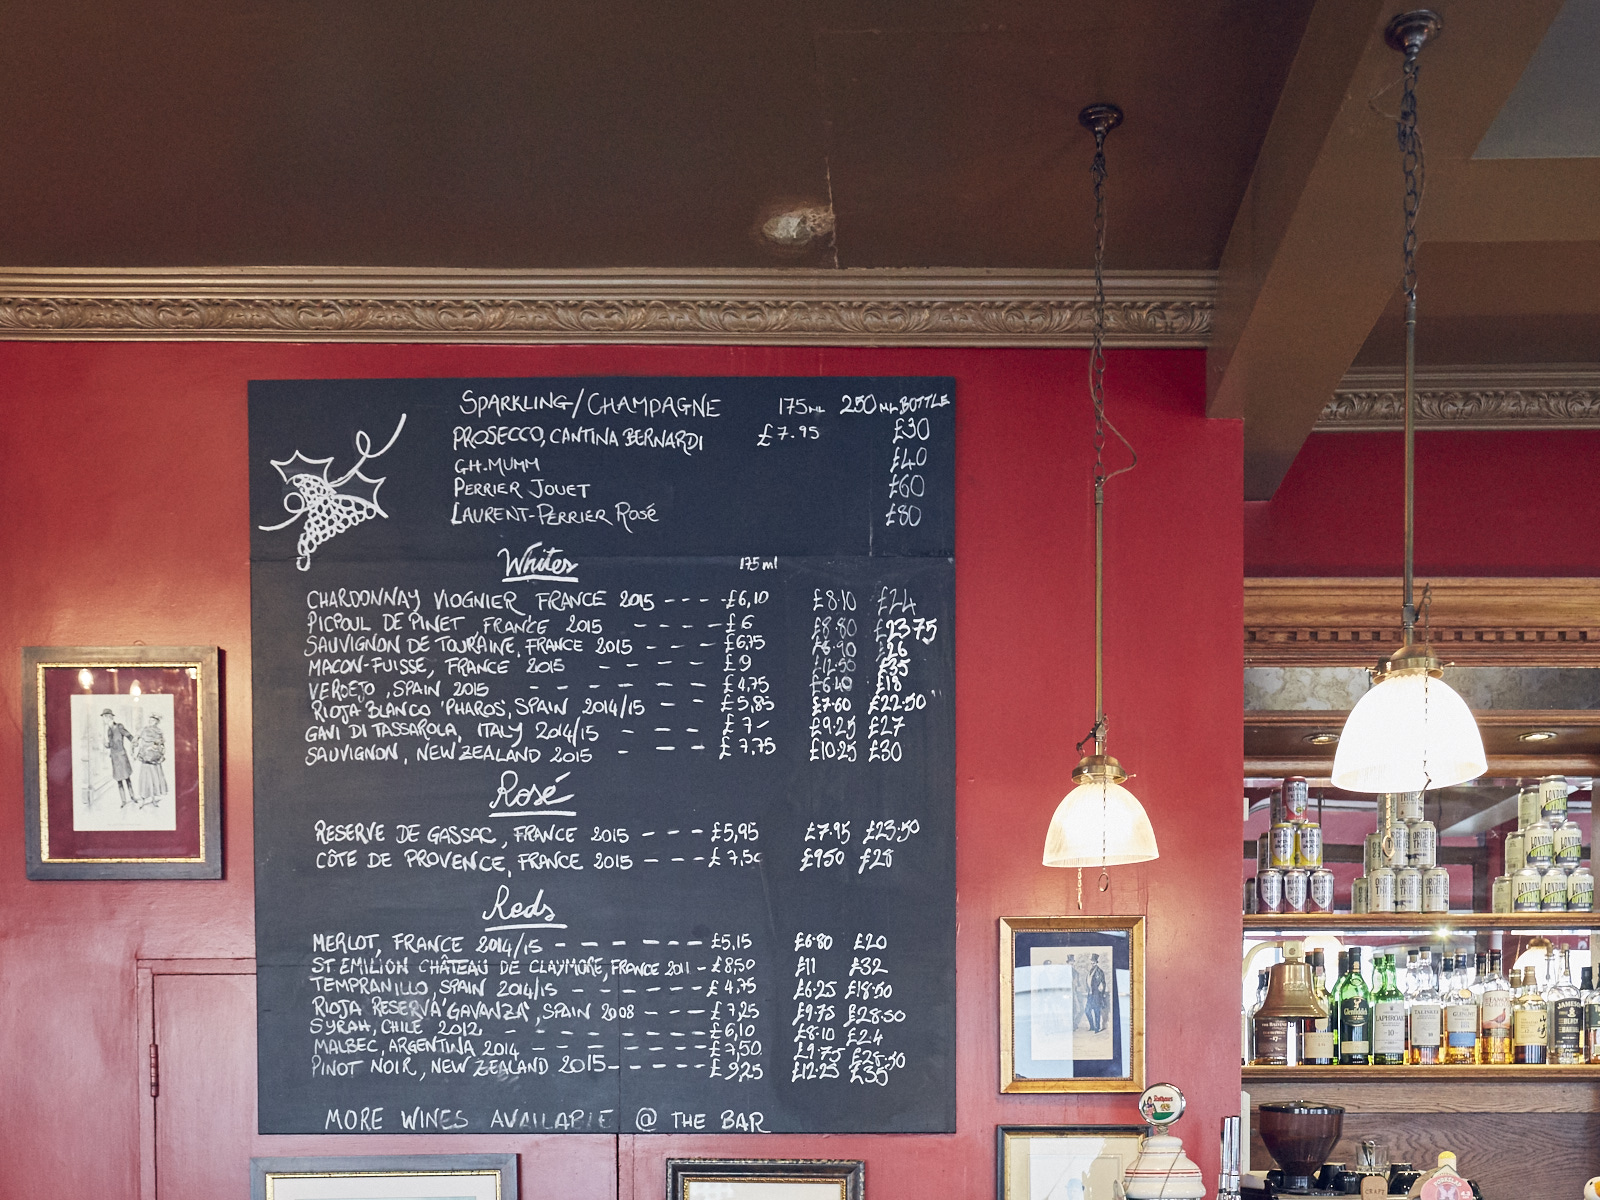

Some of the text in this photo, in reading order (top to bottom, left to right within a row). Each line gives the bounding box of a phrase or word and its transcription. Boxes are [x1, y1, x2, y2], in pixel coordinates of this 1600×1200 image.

[899, 393, 950, 414] BOTTLE
[453, 426, 545, 451] PROSECCO,
[550, 426, 618, 447] CANTINA
[622, 427, 703, 455] BERNARDI
[892, 417, 930, 444] £30
[890, 446, 927, 473] £40
[454, 474, 924, 499] PERRIER JOUET £60
[451, 501, 613, 526] LAURENT-PERRIER
[885, 503, 922, 527] £80
[497, 541, 579, 577] Whites
[307, 586, 420, 611] CHARDONNAY
[535, 590, 606, 611] FRANCE
[619, 590, 655, 611] 2015
[877, 586, 916, 616] £24
[307, 611, 371, 633] PICPOUL
[383, 613, 404, 632] DE
[483, 615, 549, 636] FRANCE
[566, 615, 602, 634] 2015
[304, 634, 401, 656] SAUVIGNON
[408, 636, 430, 654] DE
[525, 638, 583, 655] FRANCE
[595, 637, 633, 655] 2015
[875, 640, 907, 661] £26
[445, 658, 509, 676] FRANCE
[526, 658, 565, 674] 2015
[879, 657, 911, 677] £35
[308, 680, 376, 703] VERDEJO
[453, 681, 489, 697] 2015
[875, 675, 902, 695] £18
[311, 700, 360, 724] RIOJA
[367, 700, 430, 719] BLANCO
[515, 697, 569, 716] SPAIN
[582, 694, 645, 718] 2014/15
[867, 693, 926, 715] £22.50
[305, 724, 340, 742] GAVI
[349, 724, 367, 739] DI
[477, 723, 523, 747] ITALY
[535, 716, 599, 747] 2014/15
[867, 715, 905, 739] £27
[416, 742, 457, 761] NEW
[459, 745, 541, 763] ZEALAND
[550, 746, 592, 763] 2015
[867, 738, 902, 762] £30
[489, 770, 575, 808] Rosé
[314, 820, 385, 845] RESERVE
[396, 824, 420, 842] DE
[513, 824, 577, 842] FRANCE
[591, 828, 630, 842] 2015
[316, 850, 358, 868] CÔTE
[367, 852, 392, 868] DE
[518, 851, 584, 871] FRANCE
[593, 854, 633, 870] 2015
[857, 847, 894, 874] £28
[481, 884, 556, 921] Reds
[313, 932, 382, 958] MERLOT,
[391, 934, 465, 953] FRANCE
[475, 931, 543, 961] 2014/15
[853, 932, 888, 951] £20
[311, 957, 333, 974] ST
[340, 959, 409, 975] EMILION
[500, 958, 521, 975] DE
[611, 959, 659, 977] FRANCE
[664, 960, 690, 976] 2011
[794, 957, 816, 977] £11
[849, 957, 888, 977] £32
[438, 977, 487, 997] SPAIN
[496, 976, 558, 1001] 2014/15
[312, 995, 362, 1019] RIOJA
[371, 995, 442, 1020] RESERVA
[543, 1002, 591, 1020] SPAIN
[601, 1003, 635, 1021] 2008
[1557, 1001, 1581, 1010] JAMESO
[381, 1019, 424, 1035] CHILE
[438, 1020, 483, 1036] 2012
[794, 1023, 834, 1043] £8.10
[389, 1036, 476, 1057] ARGENTINA
[483, 1041, 520, 1057] 2014
[312, 1054, 364, 1078] PINOT
[431, 1056, 473, 1075] NEW
[473, 1056, 549, 1077] ZEALAND
[558, 1055, 606, 1074] 2015
[850, 1064, 889, 1086] £35
[325, 1107, 384, 1132] MORE
[401, 1106, 469, 1131] WINES
[635, 1107, 658, 1132] @
[671, 1110, 706, 1130] THE
[721, 1109, 771, 1133] BAR
